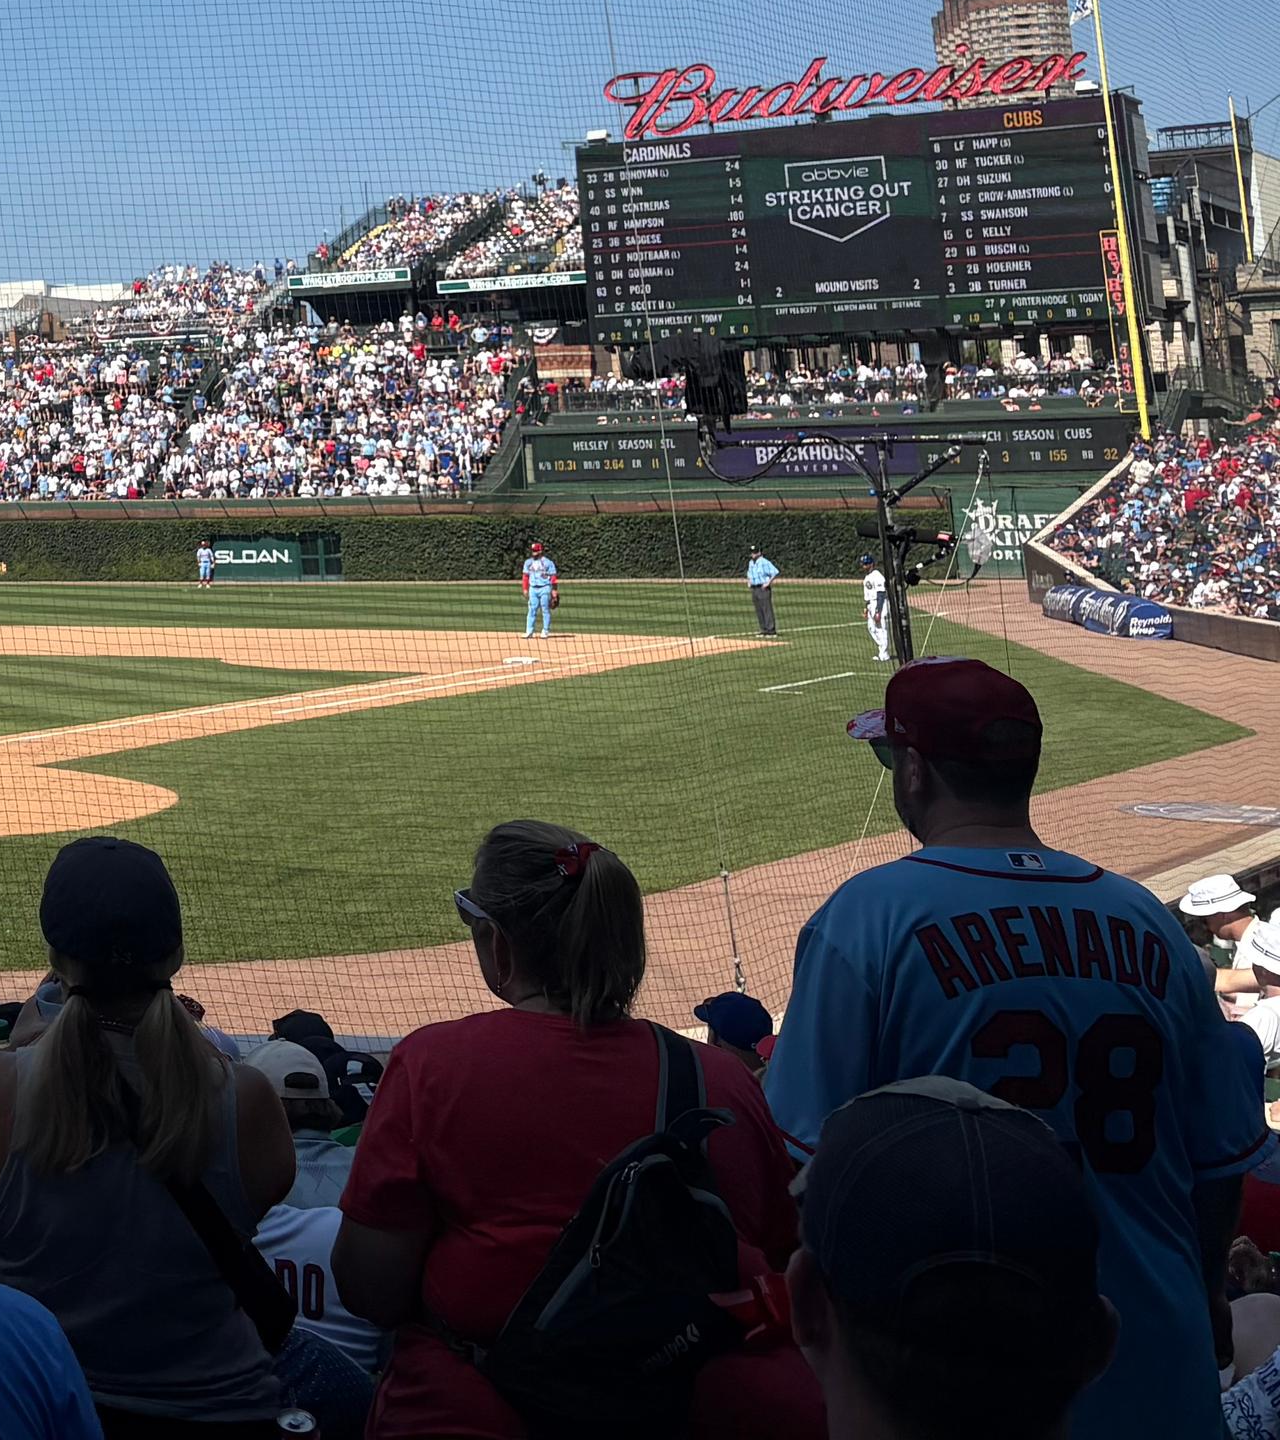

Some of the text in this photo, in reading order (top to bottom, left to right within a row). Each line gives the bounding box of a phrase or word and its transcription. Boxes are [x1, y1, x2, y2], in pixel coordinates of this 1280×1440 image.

[604, 43, 1088, 139] Budweiser
[1003, 110, 1043, 128] CUBS
[972, 138, 998, 150] HAPP
[623, 142, 692, 163] CARDINALS
[725, 161, 740, 172] 2-4
[974, 154, 1012, 167] TUCKER
[801, 165, 869, 182] abbvie
[937, 172, 1011, 188] 27 SUZUKI
[621, 187, 643, 197] WNN
[765, 181, 912, 207] STRIKING OUT
[959, 186, 1061, 204] CF CROW-ARMSTRONG
[622, 201, 670, 213] CONTRERAS
[797, 201, 882, 220] CANCER
[961, 207, 1028, 222] SS SWANSON
[624, 218, 665, 230] HAMPSON
[732, 228, 746, 238] 2-4
[983, 226, 1011, 238] KELLY
[984, 244, 1017, 255] BUSCH
[735, 261, 749, 272] 2-4
[946, 261, 1032, 276] 2 HOERNER
[775, 278, 921, 298] 2 MOUND VISITS 2
[988, 279, 1027, 291] TURNER
[737, 294, 753, 305] 0-4
[1078, 293, 1104, 303] TODAY
[1012, 429, 1054, 441] SEASON
[1064, 428, 1093, 440] CUBS
[573, 438, 676, 451] HELSLEY SEASON STL
[1002, 451, 1009, 462] 3
[1049, 449, 1067, 461] 155
[1104, 448, 1118, 460] 32
[554, 460, 577, 471] 10.31
[786, 464, 838, 473] TAVERN
[214, 549, 289, 563] SLOAN
[1130, 614, 1173, 628] Reynolds
[1129, 625, 1156, 636] Wrap
[914, 906, 1172, 1002] ARENADO
